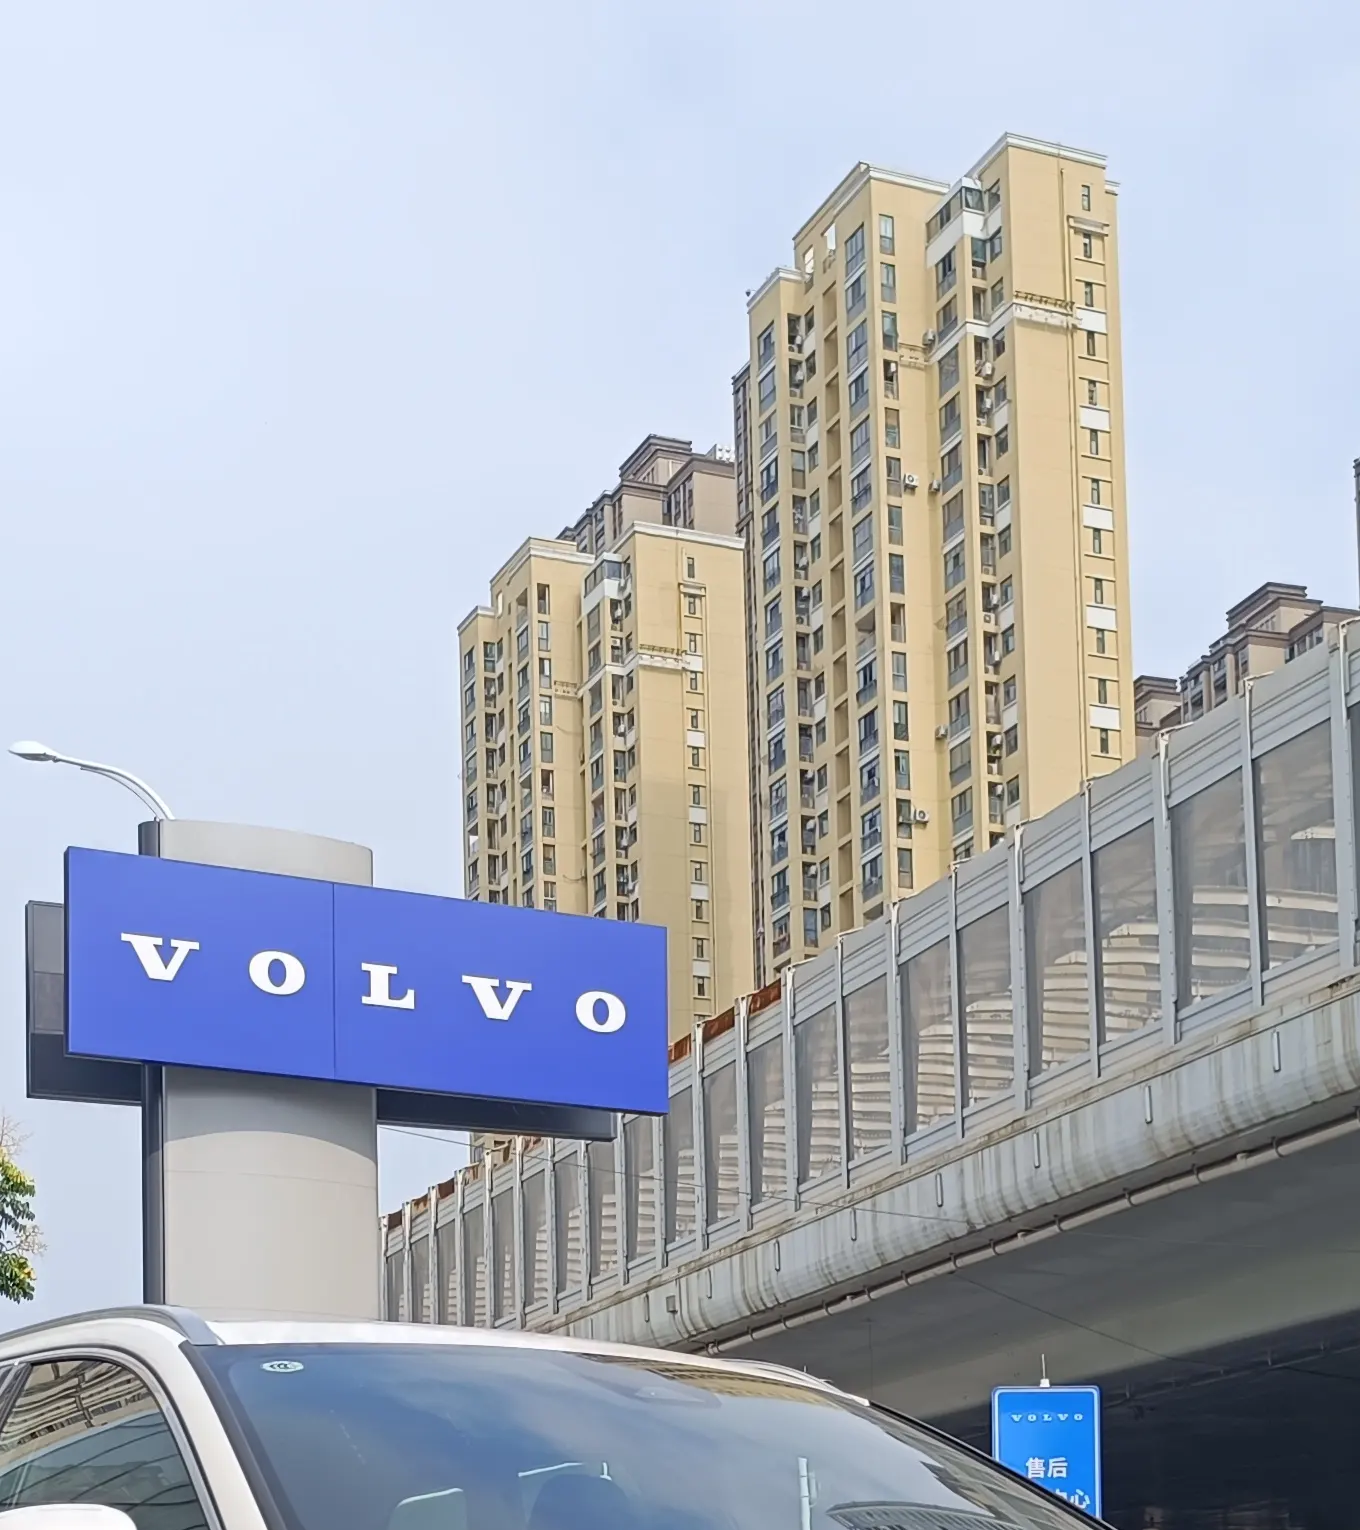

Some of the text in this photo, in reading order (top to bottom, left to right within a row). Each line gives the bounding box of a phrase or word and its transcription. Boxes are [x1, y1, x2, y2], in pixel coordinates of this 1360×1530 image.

[121, 932, 626, 1033] VOLVO
[1011, 1413, 1083, 1422] VOLVO
[1025, 1457, 1068, 1479] 售后
